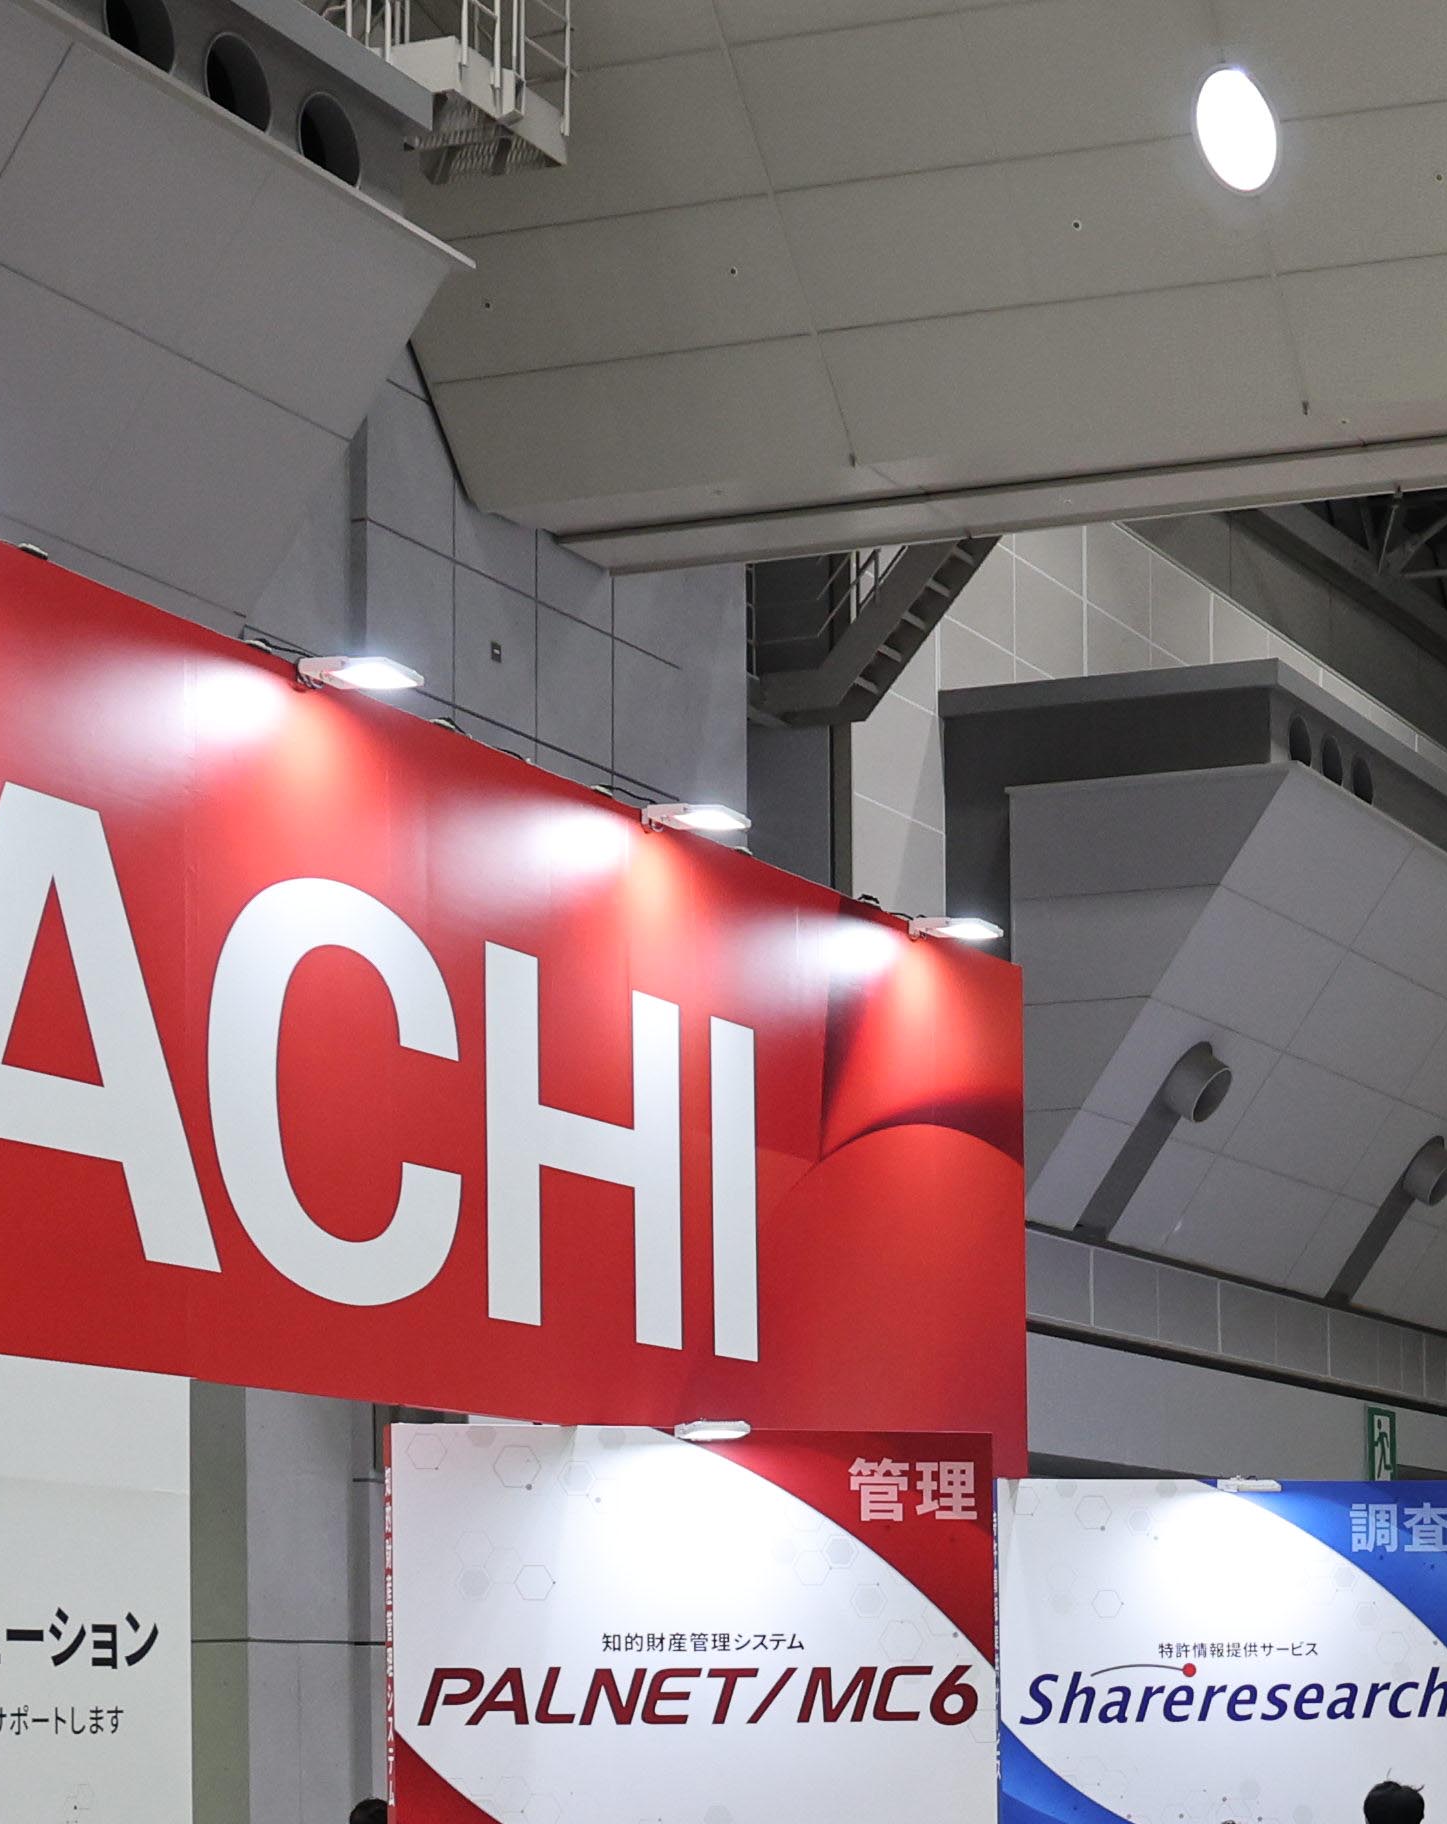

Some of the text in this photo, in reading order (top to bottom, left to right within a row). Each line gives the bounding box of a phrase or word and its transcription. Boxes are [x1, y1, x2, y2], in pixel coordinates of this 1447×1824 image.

[849, 1457, 978, 1522] 管理
[601, 1632, 805, 1653] 知的財産管理システム
[1158, 1641, 1320, 1659] 特許情報提供サービス
[417, 1664, 979, 1726] PALNET/MC6
